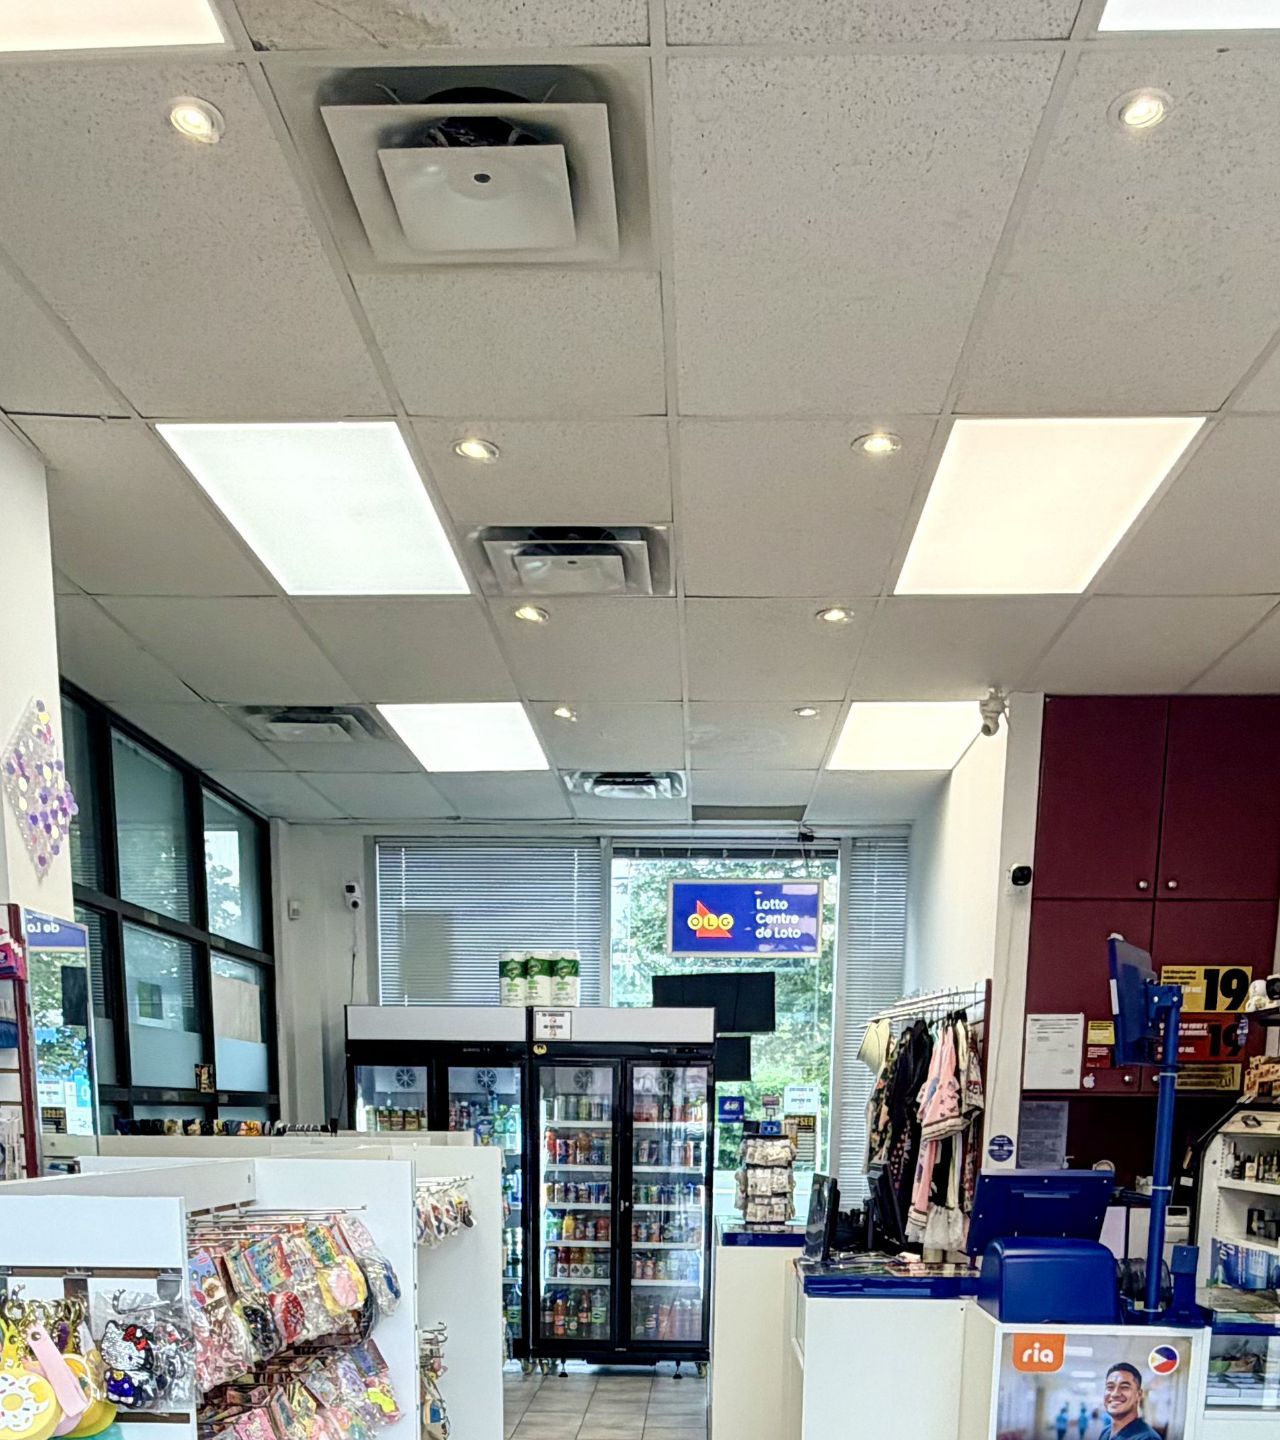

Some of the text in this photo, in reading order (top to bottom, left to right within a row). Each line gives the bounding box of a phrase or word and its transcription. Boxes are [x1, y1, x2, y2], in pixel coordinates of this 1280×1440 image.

[756, 898, 788, 910] Lotto
[689, 915, 733, 929] OLG
[755, 913, 800, 924] Centre
[755, 928, 801, 938] de Loto
[1204, 968, 1250, 1011] 19
[1208, 1023, 1244, 1057] 19
[1022, 1342, 1054, 1363] ria
